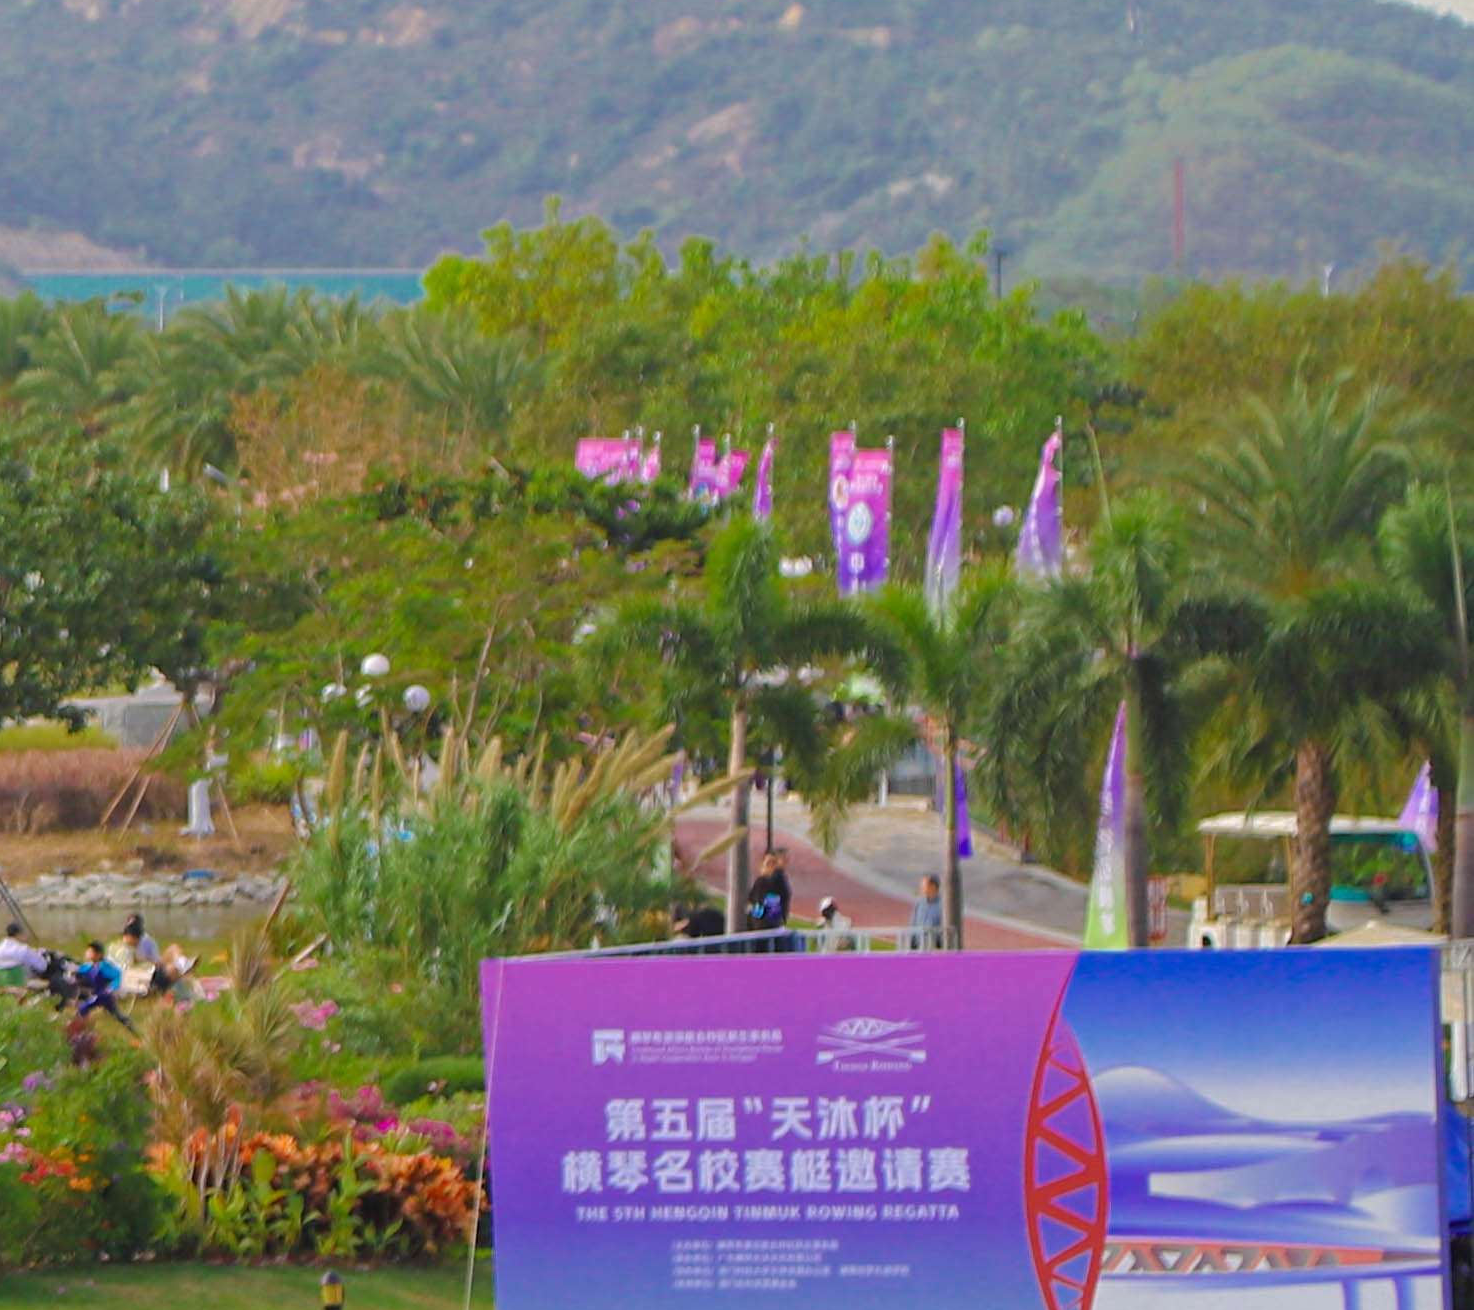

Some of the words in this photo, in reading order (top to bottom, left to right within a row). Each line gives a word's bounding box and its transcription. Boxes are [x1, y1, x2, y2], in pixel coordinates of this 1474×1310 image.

[562, 1146, 971, 1193] 横琴名校赛艇邀请赛
[807, 1204, 877, 1221] ROWING
